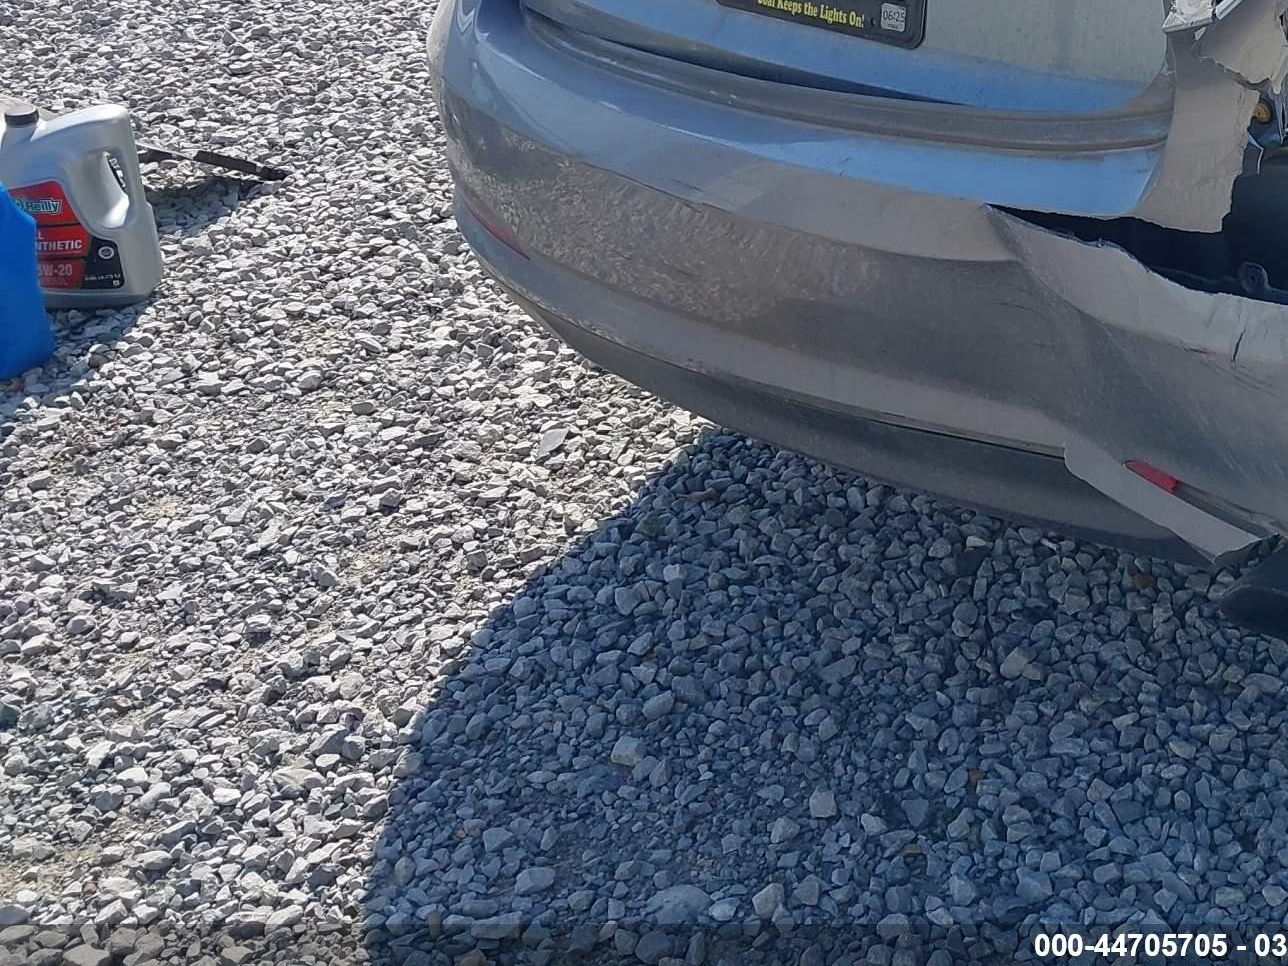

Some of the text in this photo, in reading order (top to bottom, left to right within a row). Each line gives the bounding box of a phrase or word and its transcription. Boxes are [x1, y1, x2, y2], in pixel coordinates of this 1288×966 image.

[803, 1, 818, 16] the
[819, 3, 847, 24] Lights
[848, 10, 865, 28] On!
[34, 239, 83, 251] NTHETIC
